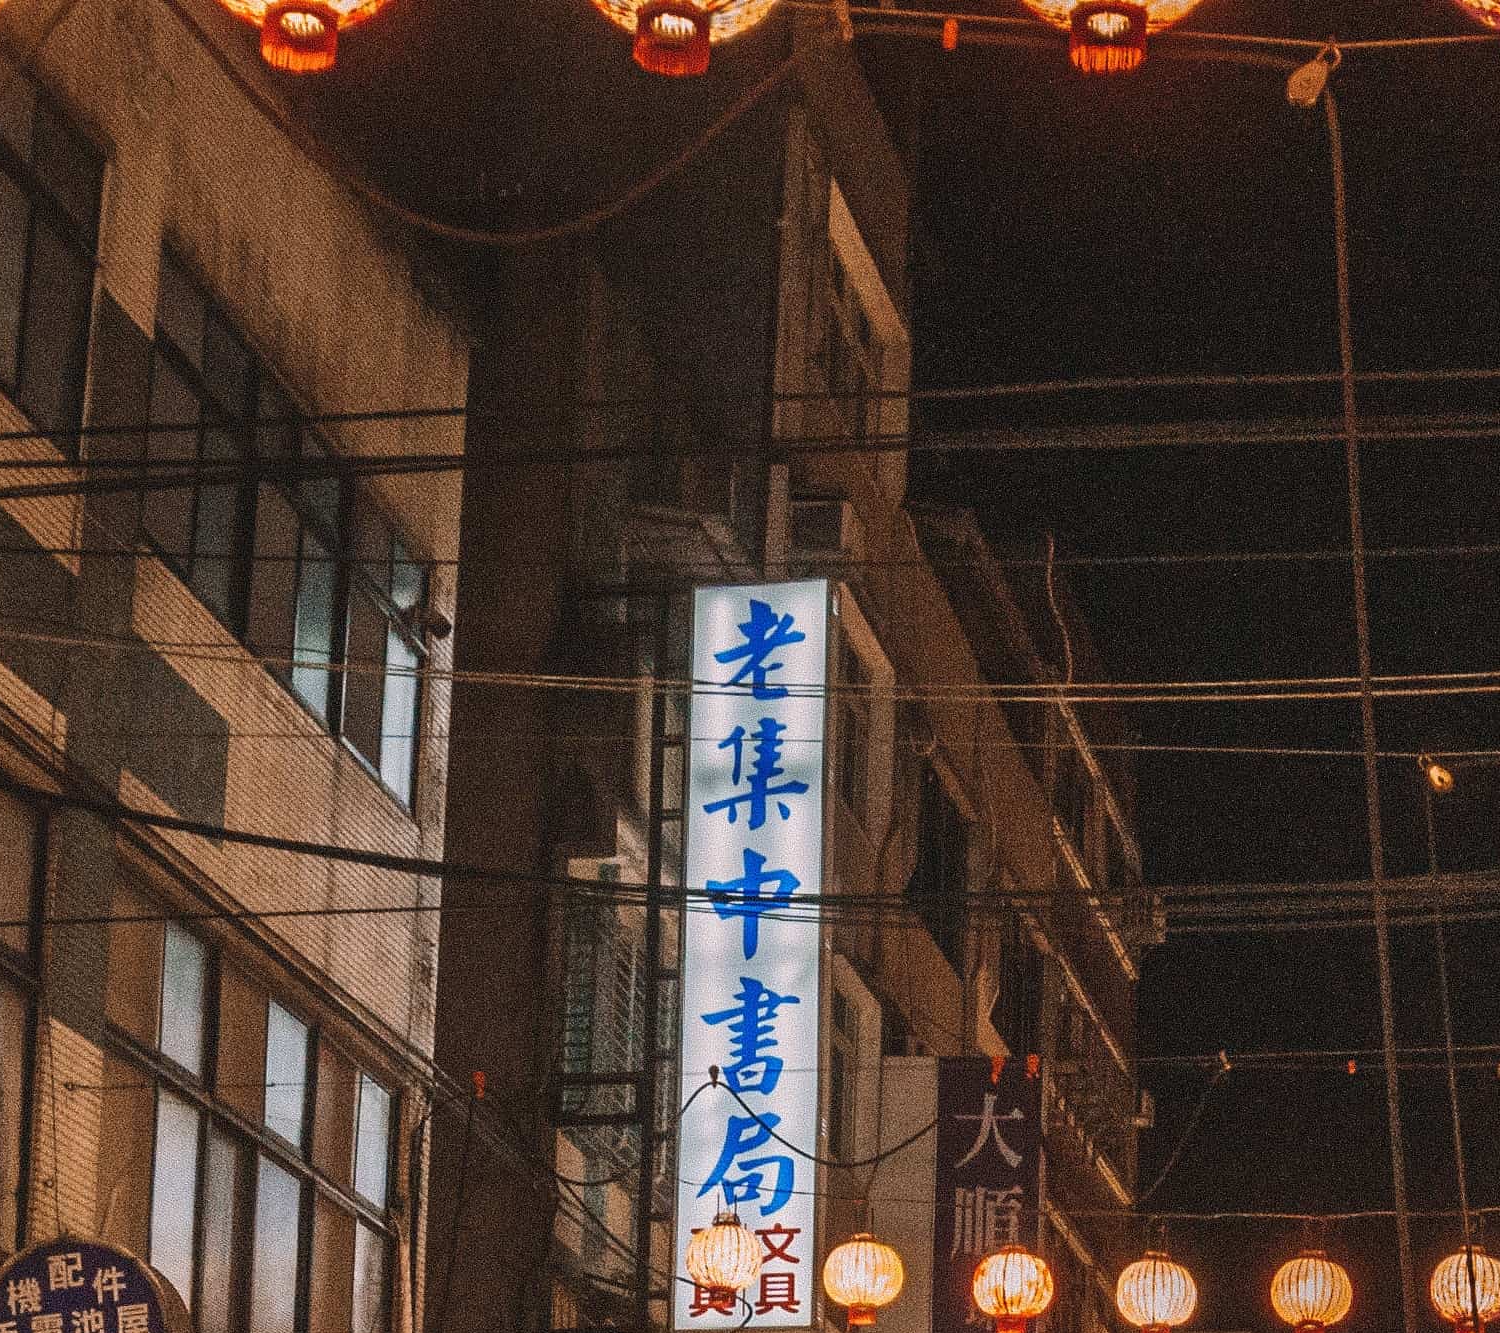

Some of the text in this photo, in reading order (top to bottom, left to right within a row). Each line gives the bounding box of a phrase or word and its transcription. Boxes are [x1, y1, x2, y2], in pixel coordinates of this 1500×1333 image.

[690, 600, 808, 1217] 老集中書局
[754, 1222, 802, 1316] 文具
